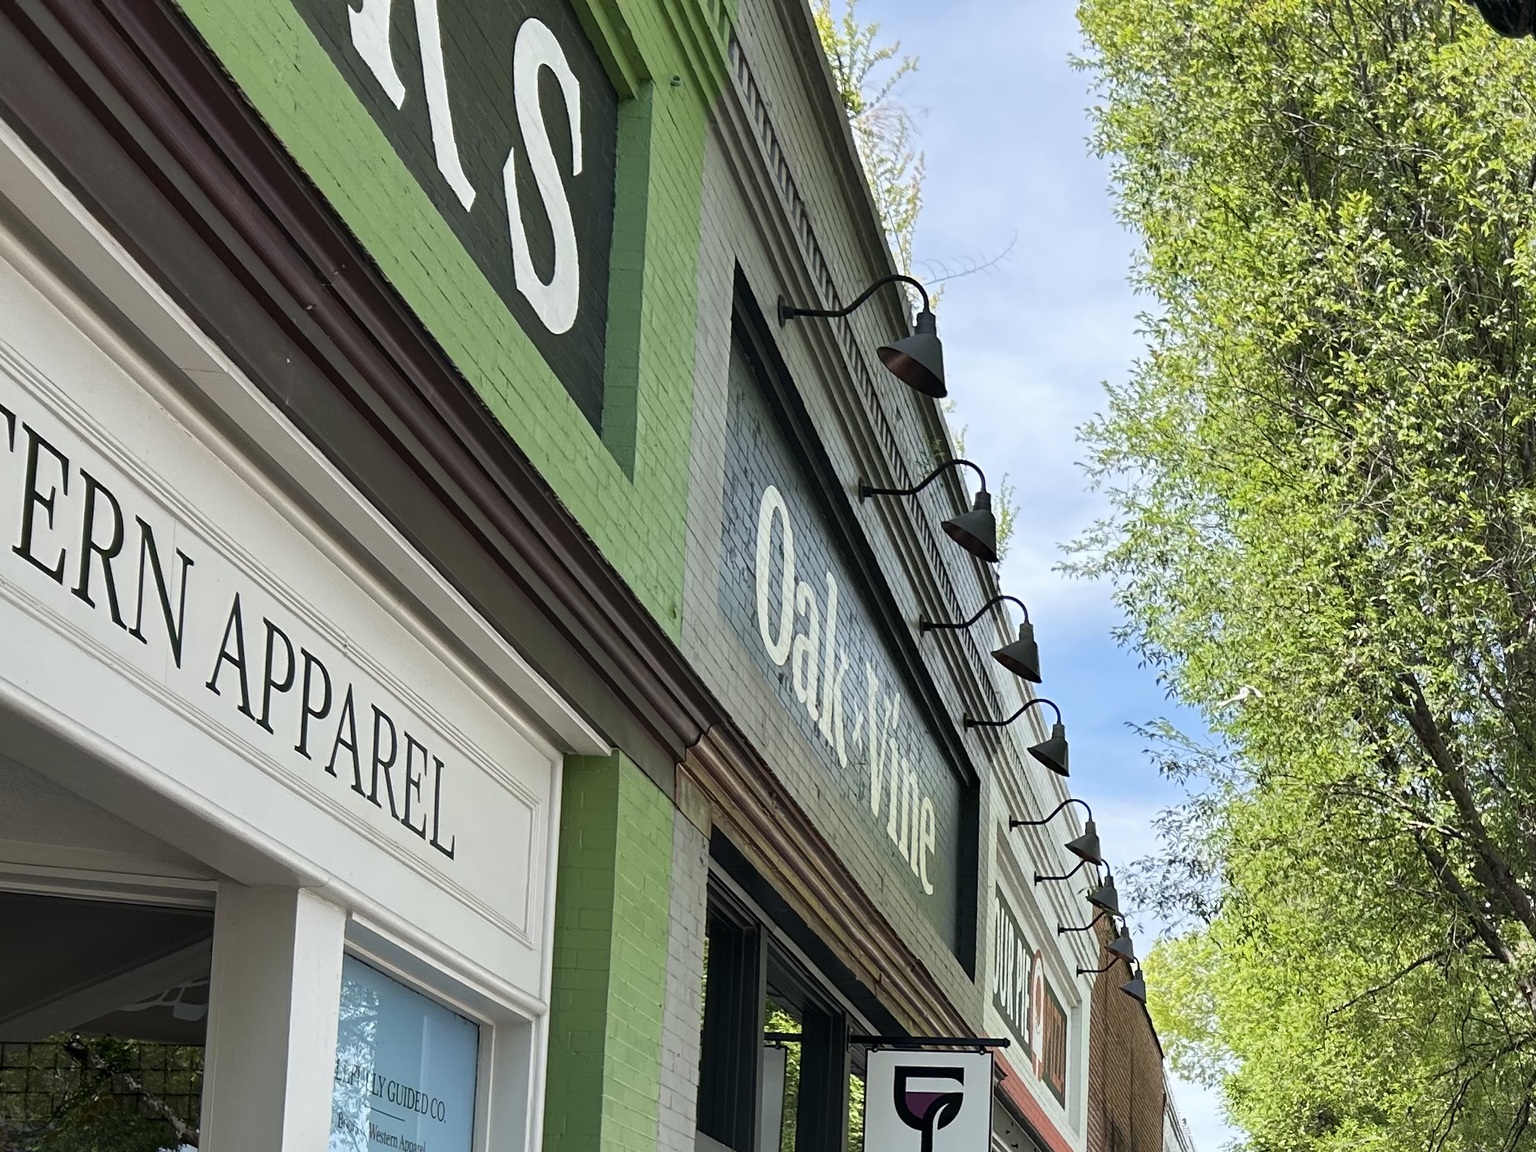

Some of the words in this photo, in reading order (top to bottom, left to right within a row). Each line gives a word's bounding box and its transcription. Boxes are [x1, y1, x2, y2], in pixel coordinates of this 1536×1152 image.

[205, 591, 455, 861] APPAREL
[756, 484, 848, 769] Oak
[866, 662, 936, 896] Vine
[369, 1122, 398, 1149] Western
[387, 1080, 429, 1115] GUIDED
[430, 1098, 447, 1123] CO.
